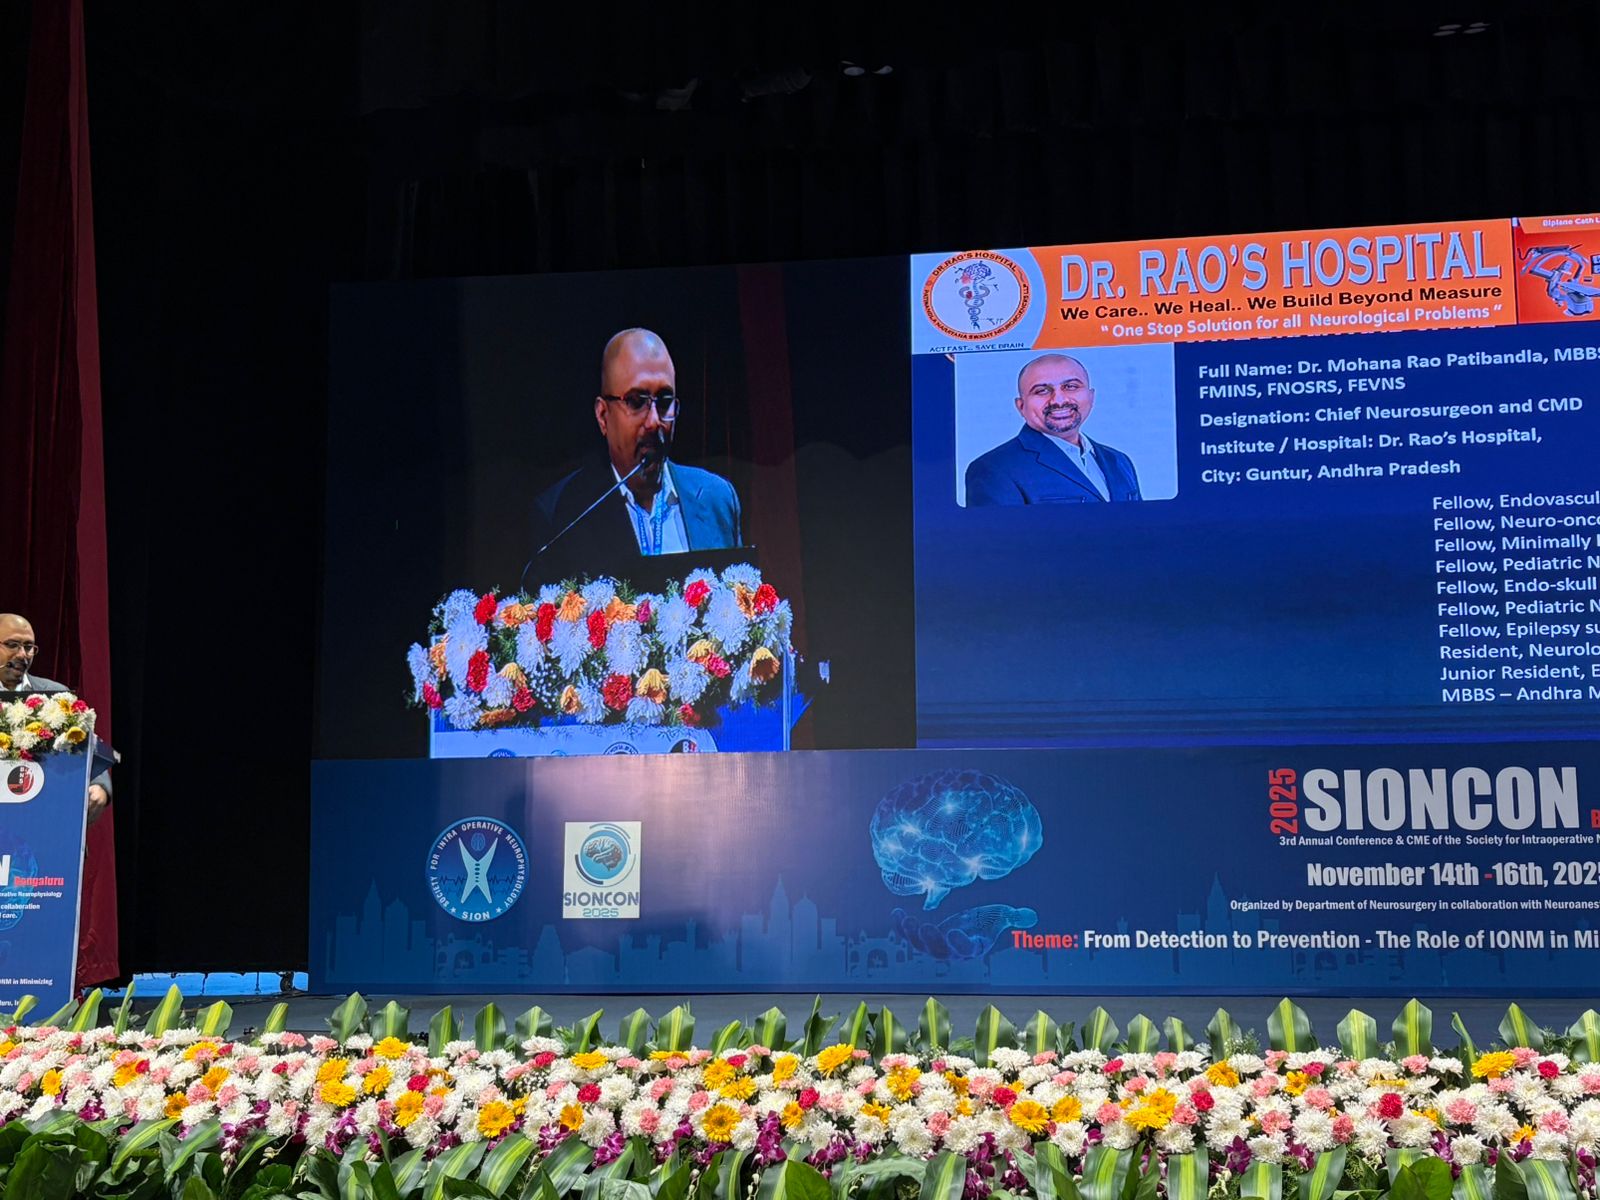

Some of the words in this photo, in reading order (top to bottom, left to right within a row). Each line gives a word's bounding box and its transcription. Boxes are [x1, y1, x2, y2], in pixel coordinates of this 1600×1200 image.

[975, 252, 1017, 272] HOSPITAL
[1281, 230, 1502, 289] HOSPITAL
[1060, 307, 1089, 320] We
[1095, 305, 1148, 319] Care..
[1154, 301, 1183, 315] We
[1190, 298, 1241, 313] Heal..
[1247, 296, 1277, 310] We
[1282, 293, 1333, 308] Build
[1338, 289, 1413, 307] Beyond
[1420, 286, 1502, 301] Measure
[1112, 324, 1143, 338] One
[1148, 322, 1183, 337] Stop
[1187, 317, 1252, 334] Solution
[1256, 316, 1279, 330] for
[1283, 314, 1301, 329] all
[1309, 307, 1410, 327] Neurological
[1414, 306, 1489, 322] Problems
[1198, 364, 1230, 379] Full
[1235, 363, 1292, 377] Name:
[1297, 360, 1322, 374] Dr.
[1327, 357, 1402, 372] Mohana
[1407, 355, 1441, 368] Rao
[1447, 349, 1549, 367] Patibandla,
[1554, 347, 1600, 362] MBB
[1199, 383, 1262, 399] FMINS,
[1267, 380, 1343, 396] FNOSRS,
[1348, 377, 1406, 392] FEVNS
[1200, 410, 1310, 428] Designation:
[1314, 406, 1361, 422] Chief
[1366, 402, 1493, 420] Neurosurgeon
[1499, 399, 1533, 413] and
[1537, 397, 1583, 412] CMD
[1200, 440, 1275, 455] Institute
[1293, 434, 1373, 452] Hospital:
[1378, 434, 1403, 448] Dr.
[1409, 431, 1457, 446] Rao’s
[1461, 427, 1542, 445] Hospital,
[1201, 469, 1241, 485] City:
[1246, 467, 1313, 481] Guntur,
[1317, 463, 1383, 478] Andhra
[1389, 459, 1461, 476] Pradesh
[1433, 495, 1494, 510] Fellow,
[1500, 490, 1600, 508] Endovascul
[1433, 516, 1495, 532] Fellow,
[1435, 537, 1496, 553] Fellow,
[1502, 533, 1592, 551] Minimally
[1436, 558, 1497, 574] Fellow,
[1503, 556, 1583, 571] Pediatric
[1587, 555, 1600, 569] N
[1437, 580, 1498, 595] Fellow,
[1504, 576, 1597, 593] Endo-skull
[1438, 602, 1500, 617] Fellow,
[1505, 599, 1585, 615] Pediatric
[1439, 623, 1501, 639] Fellow,
[1506, 622, 1580, 639] Epilepsy
[1440, 644, 1524, 660] Resident,
[1529, 642, 1600, 657] Neurolo
[1440, 666, 1496, 681] Junior
[1502, 665, 1585, 680] Resident,
[1442, 688, 1495, 702] MBBS
[1516, 686, 1583, 701] Andhra
[1268, 768, 1298, 834] 2025
[1302, 766, 1580, 832] SIONCON
[461, 821, 504, 835] OPERATIVE
[437, 829, 458, 850] INTRA
[1279, 836, 1297, 846] 3rd
[1298, 836, 1333, 846] Annual
[1335, 835, 1393, 845] Conference
[1395, 836, 1404, 845] &
[1406, 836, 1430, 845] CME
[1432, 835, 1443, 845] of
[1444, 835, 1461, 845] the
[1466, 834, 1503, 846] Society
[1505, 834, 1519, 844] for
[1522, 834, 1594, 846] Intraoperative
[430, 853, 440, 870] FOR
[504, 834, 526, 908] NEUROPHYSIOLOGY
[14, 876, 64, 887] Bengaluru
[1307, 862, 1425, 887] November
[1429, 862, 1479, 886] 14th
[1553, 861, 1600, 886] 202
[430, 876, 450, 907] SOCIETY
[564, 891, 639, 906] SIONCON
[582, 907, 620, 917] 2025
[1230, 900, 1279, 911] Organized
[1282, 900, 1293, 912] by
[1295, 900, 1355, 911] Department
[1357, 900, 1367, 910] of
[1369, 900, 1437, 912] Neurosurgery
[1438, 900, 1448, 910] in
[1451, 899, 1518, 910] collaboration
[1520, 900, 1542, 910] with
[461, 911, 490, 920] SION
[1011, 930, 1078, 949] Theme:
[1084, 930, 1130, 948] From
[1136, 930, 1228, 948] Detection
[1232, 932, 1251, 949] to
[1257, 930, 1360, 949] Prevention
[1375, 930, 1411, 949] The
[1416, 930, 1460, 949] Role
[1464, 930, 1484, 949] of
[1489, 930, 1544, 949] IONM
[1550, 930, 1568, 949] in
[1574, 930, 1599, 949] Mi
[20, 978, 53, 986] Minimizing
